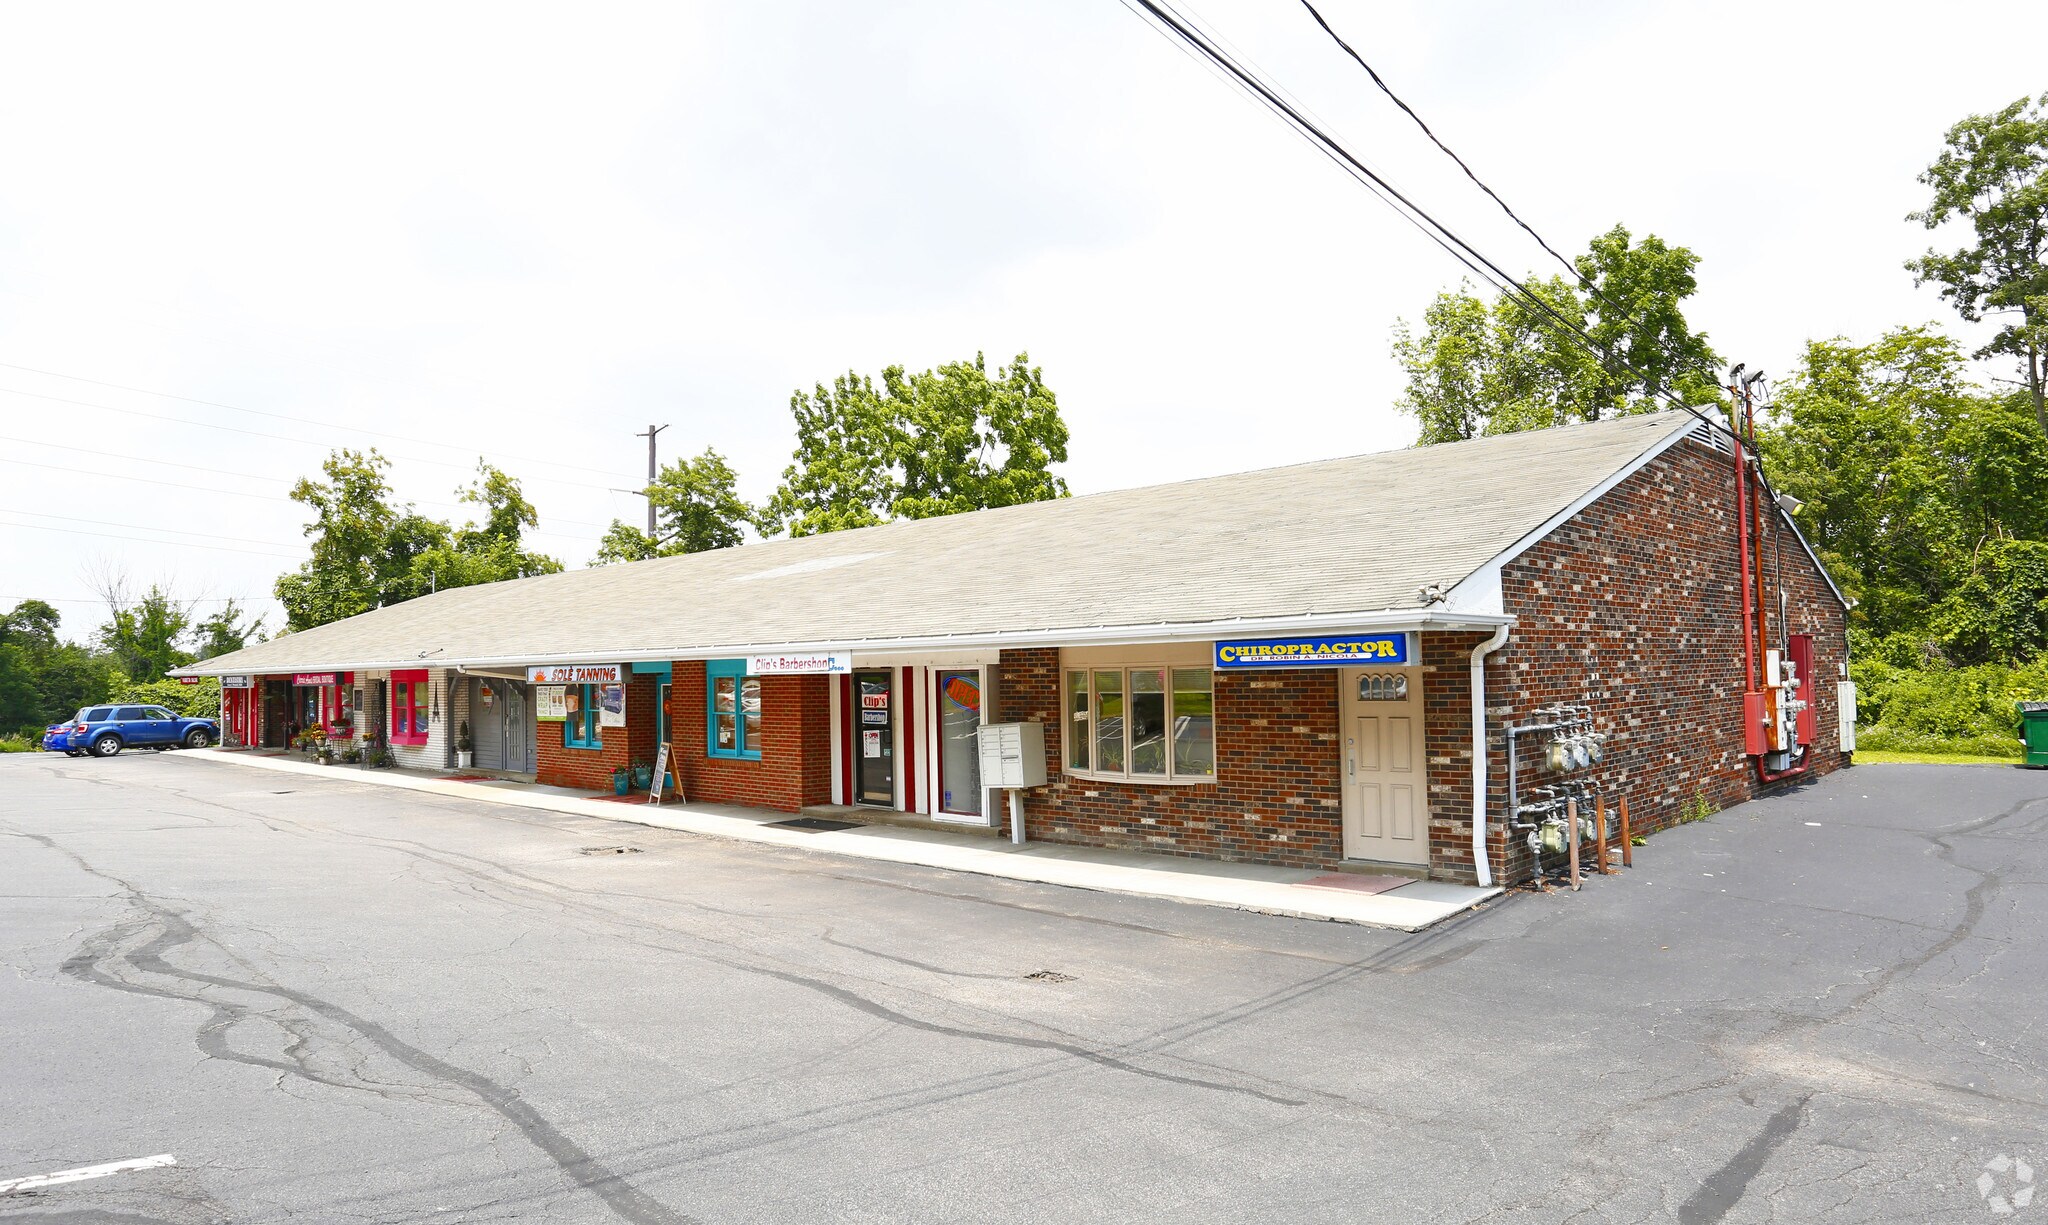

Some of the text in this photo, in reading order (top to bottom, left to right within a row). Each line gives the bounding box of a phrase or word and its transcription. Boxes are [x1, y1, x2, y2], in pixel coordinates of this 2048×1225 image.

[1219, 640, 1398, 662] CHIROPRACTOR
[576, 667, 616, 681] TANNING
[864, 696, 886, 708] Clip's
[864, 712, 886, 723] Barbershop
